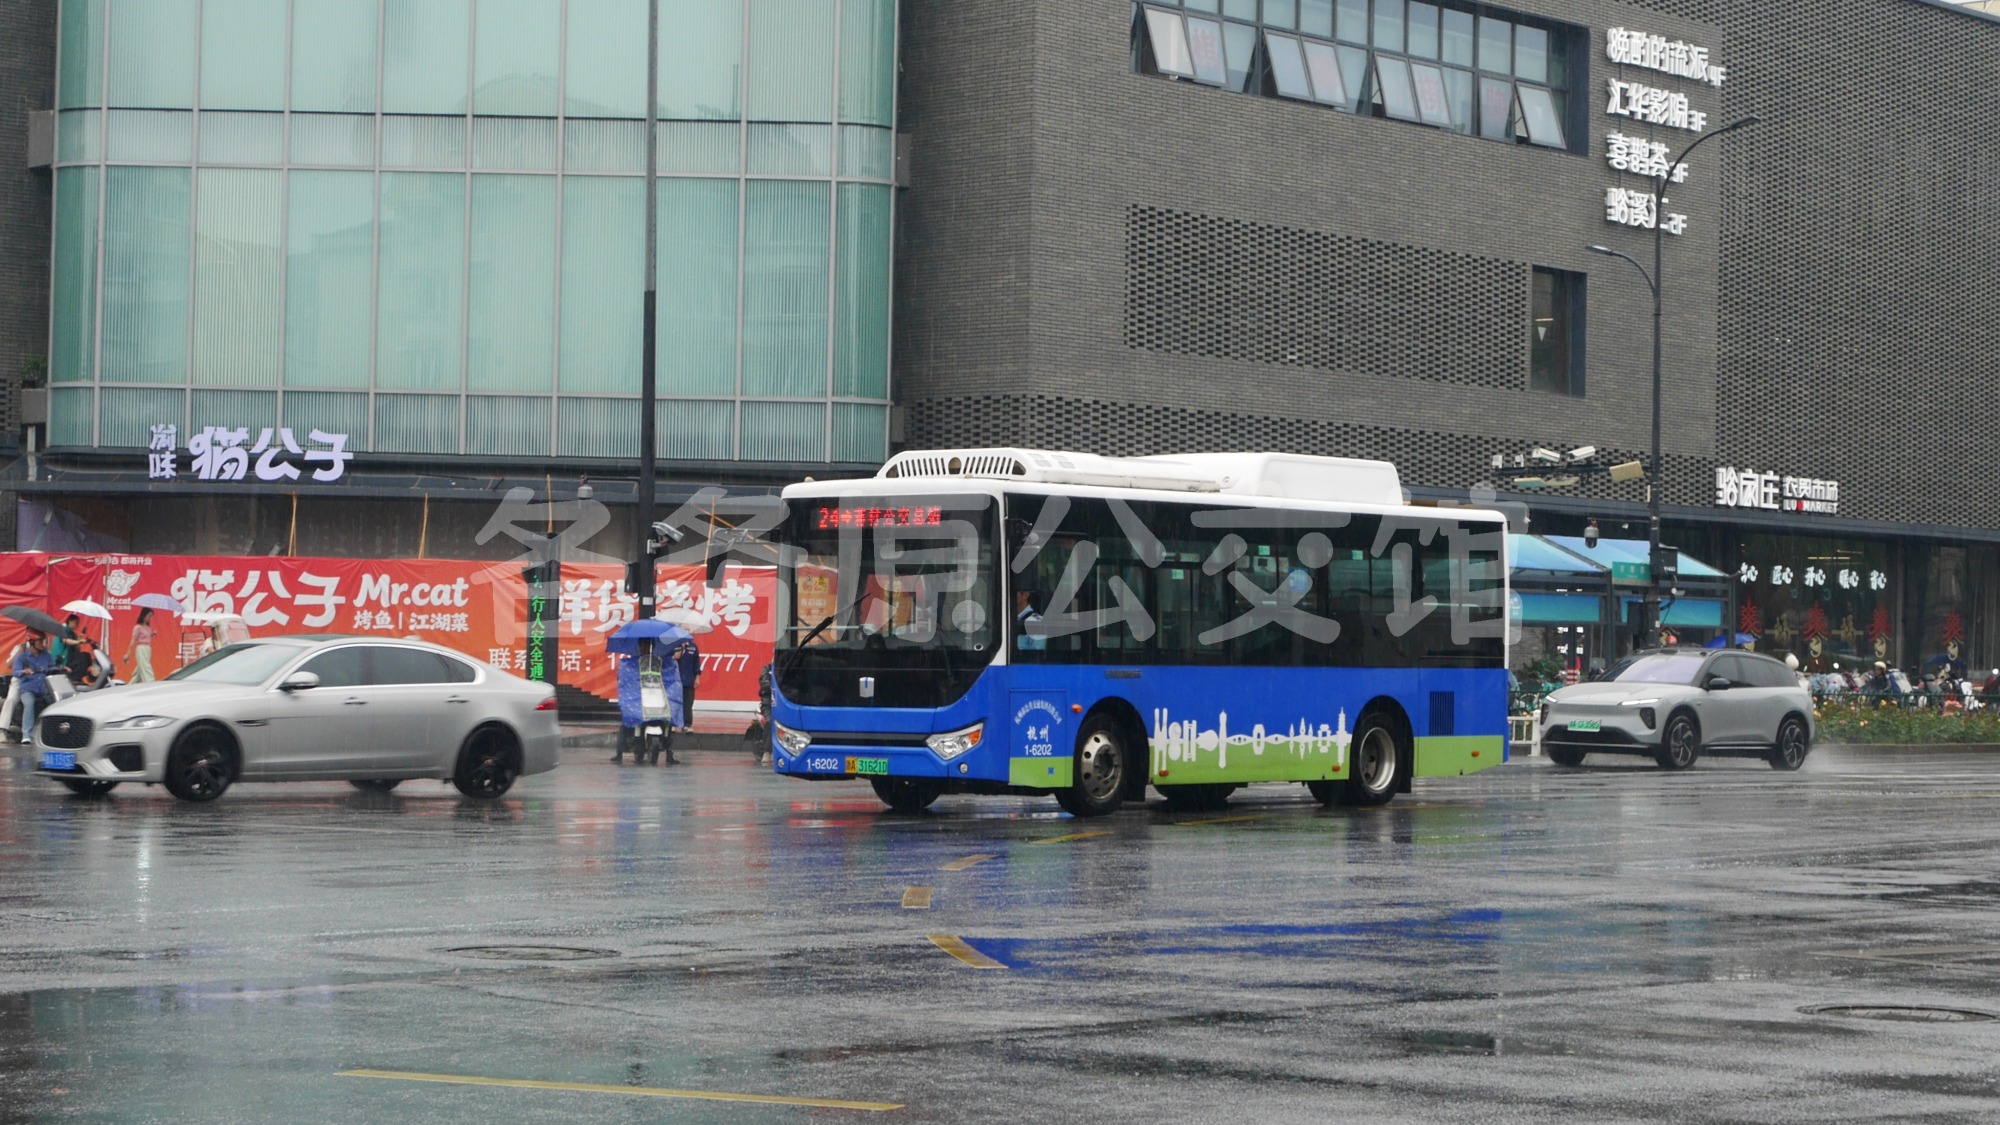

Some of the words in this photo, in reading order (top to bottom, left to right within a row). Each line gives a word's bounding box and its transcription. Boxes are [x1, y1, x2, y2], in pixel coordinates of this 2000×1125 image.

[189, 426, 353, 482] 猫公子
[1716, 467, 1780, 510] 骆家庄
[1783, 476, 1839, 501] 农贸市场
[170, 568, 346, 628] 猫公子
[353, 573, 470, 608] Mr.cat
[529, 595, 545, 683] 行人安全通
[488, 648, 592, 673] 联系话：
[806, 758, 838, 771] 1-6202
[1024, 743, 1053, 756] 1-6202
